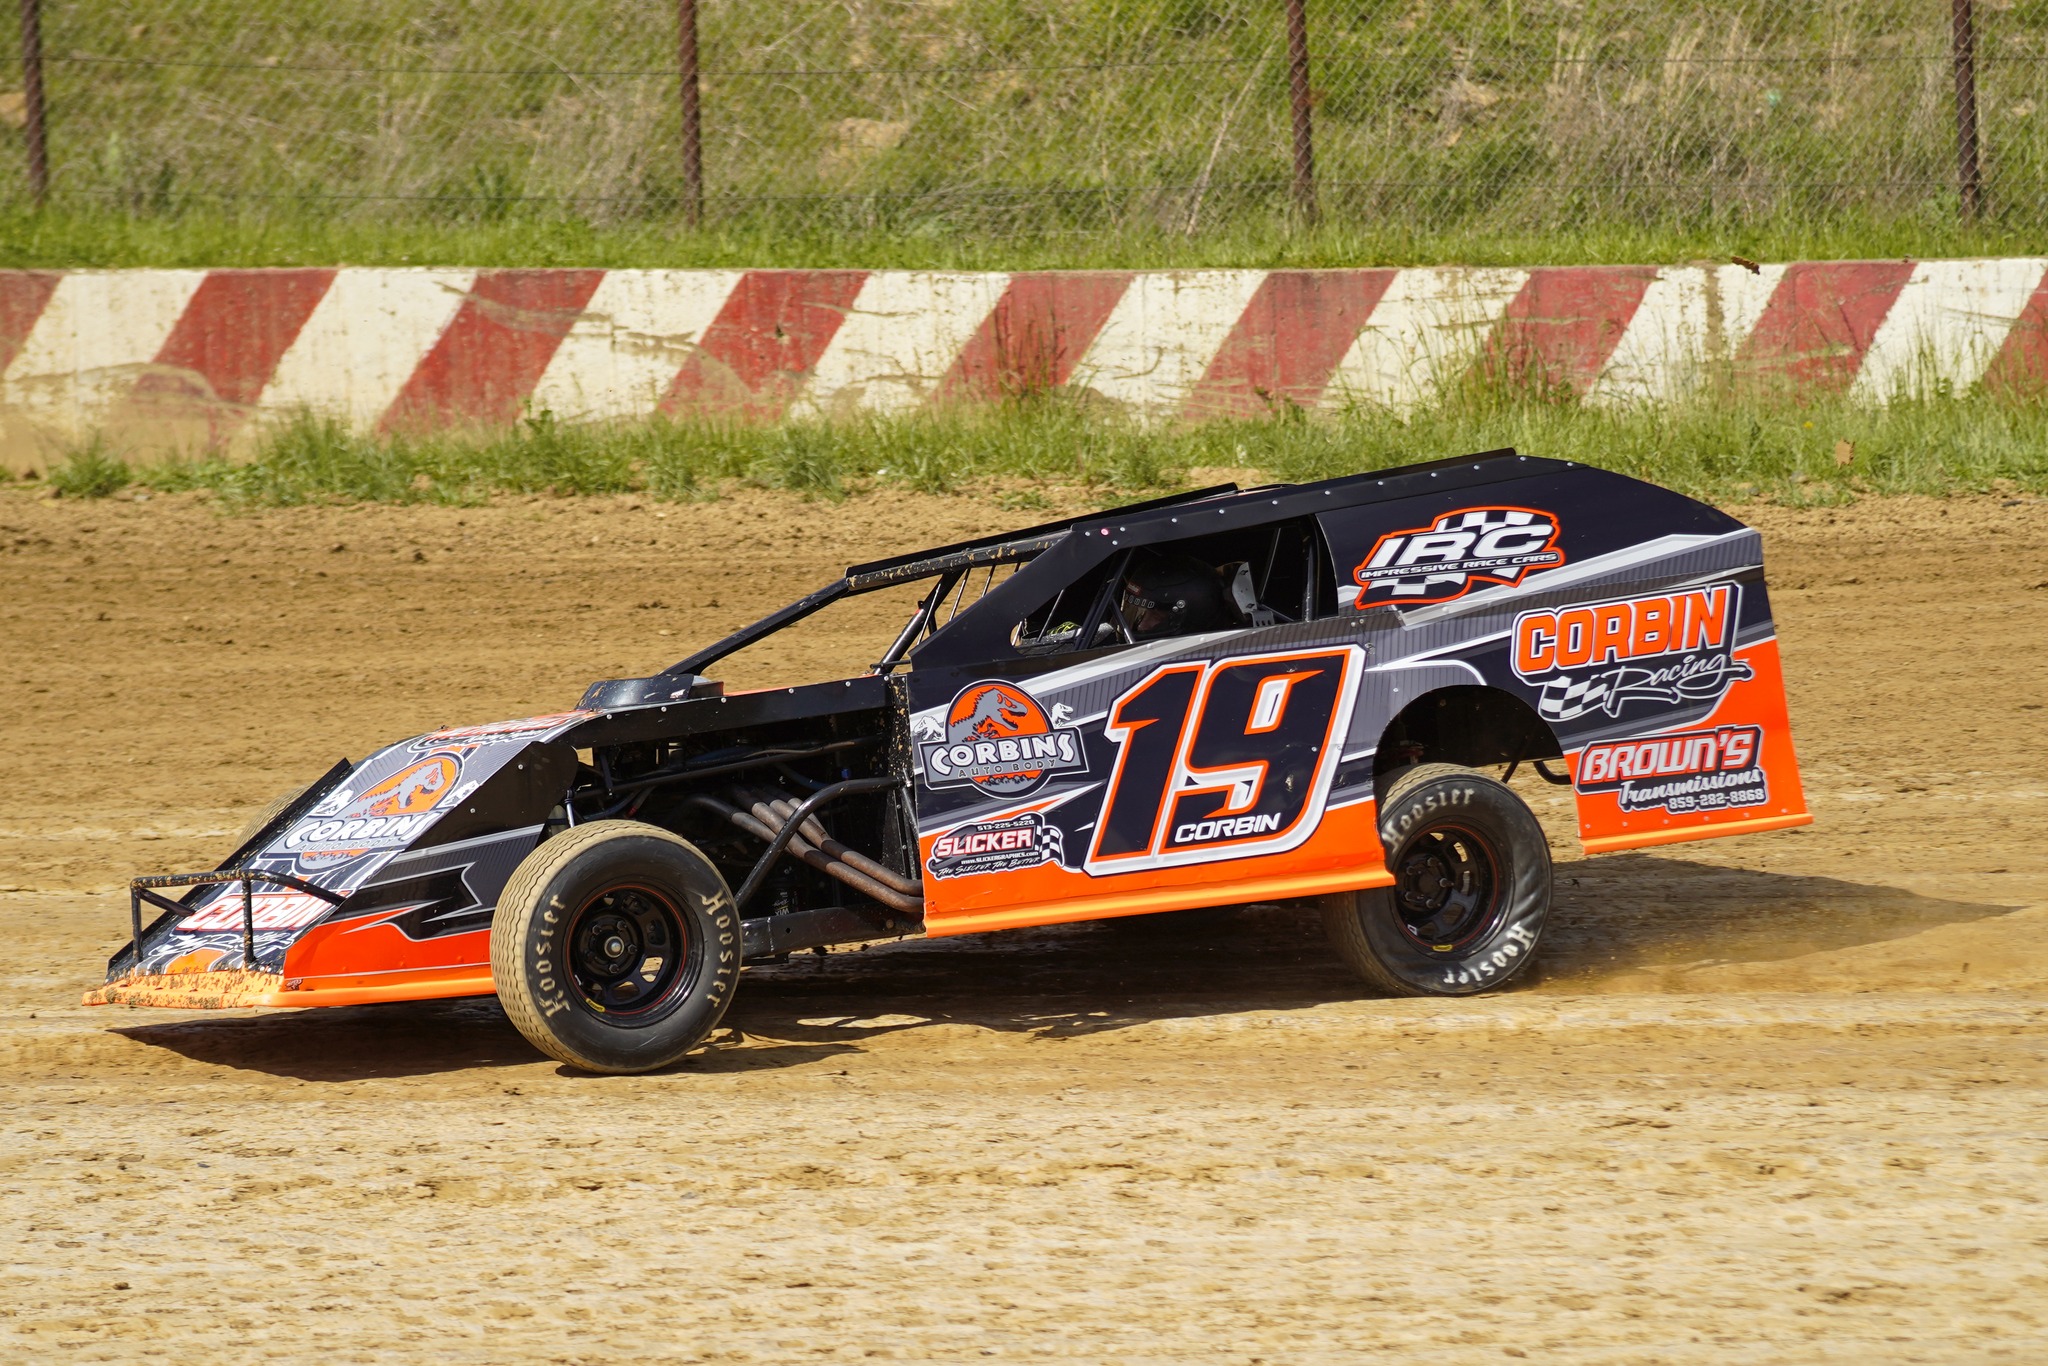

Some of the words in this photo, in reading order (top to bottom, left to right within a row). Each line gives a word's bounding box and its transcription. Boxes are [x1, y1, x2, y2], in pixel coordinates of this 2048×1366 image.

[1361, 562, 1459, 579] IMPRESSIVE
[1462, 558, 1508, 570] RACE
[1511, 552, 1558, 564] CARS
[1367, 524, 1554, 568] IRC
[1515, 586, 1731, 675] CORBIN
[1600, 654, 1747, 710] Racing
[931, 733, 1076, 776] CORBINS
[958, 765, 1003, 778] AUTO
[1012, 759, 1057, 772] BODY
[1085, 644, 1362, 875] 19
[1581, 730, 1756, 783] BROWN'S
[1620, 768, 1763, 805] Transmissions
[1668, 788, 1765, 810] 859-282-8868
[285, 811, 444, 849] CORBINS
[976, 819, 1035, 832] 513-225-5220
[1174, 812, 1282, 844] CORBIN
[1380, 783, 1475, 854] Hoosier
[936, 828, 1033, 857] SLICKER
[536, 894, 571, 1018] Hoosier
[701, 889, 734, 1008] Hoosier
[1442, 921, 1535, 985] Hoosier
